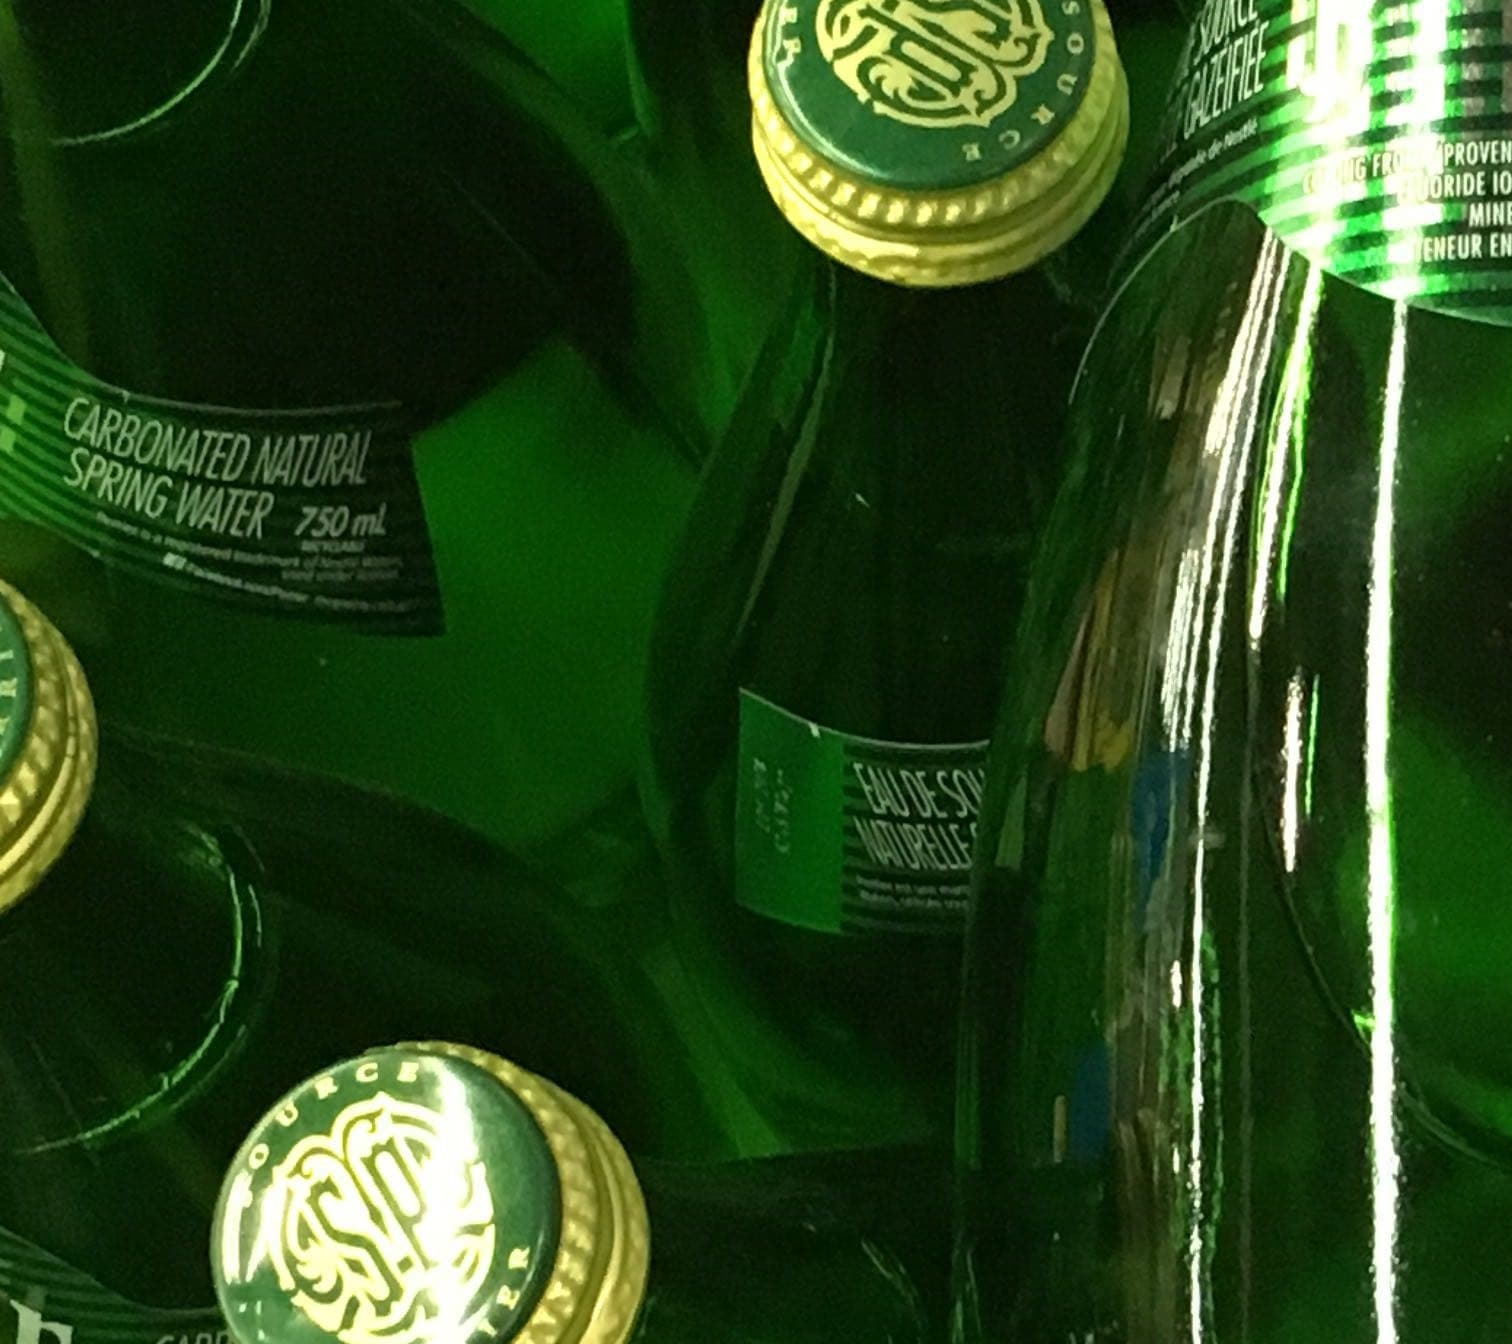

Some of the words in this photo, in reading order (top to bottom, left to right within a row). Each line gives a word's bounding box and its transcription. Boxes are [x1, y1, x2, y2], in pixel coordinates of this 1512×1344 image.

[962, 0, 1085, 161] SOURCE
[62, 396, 251, 482] CARBONATED
[249, 430, 373, 487] NATURAL
[63, 447, 174, 519] SPRING
[175, 482, 276, 540] WATER
[293, 505, 351, 538] 750
[853, 762, 911, 818] EAU
[899, 769, 949, 819] DE
[852, 815, 974, 871] NATURELLE
